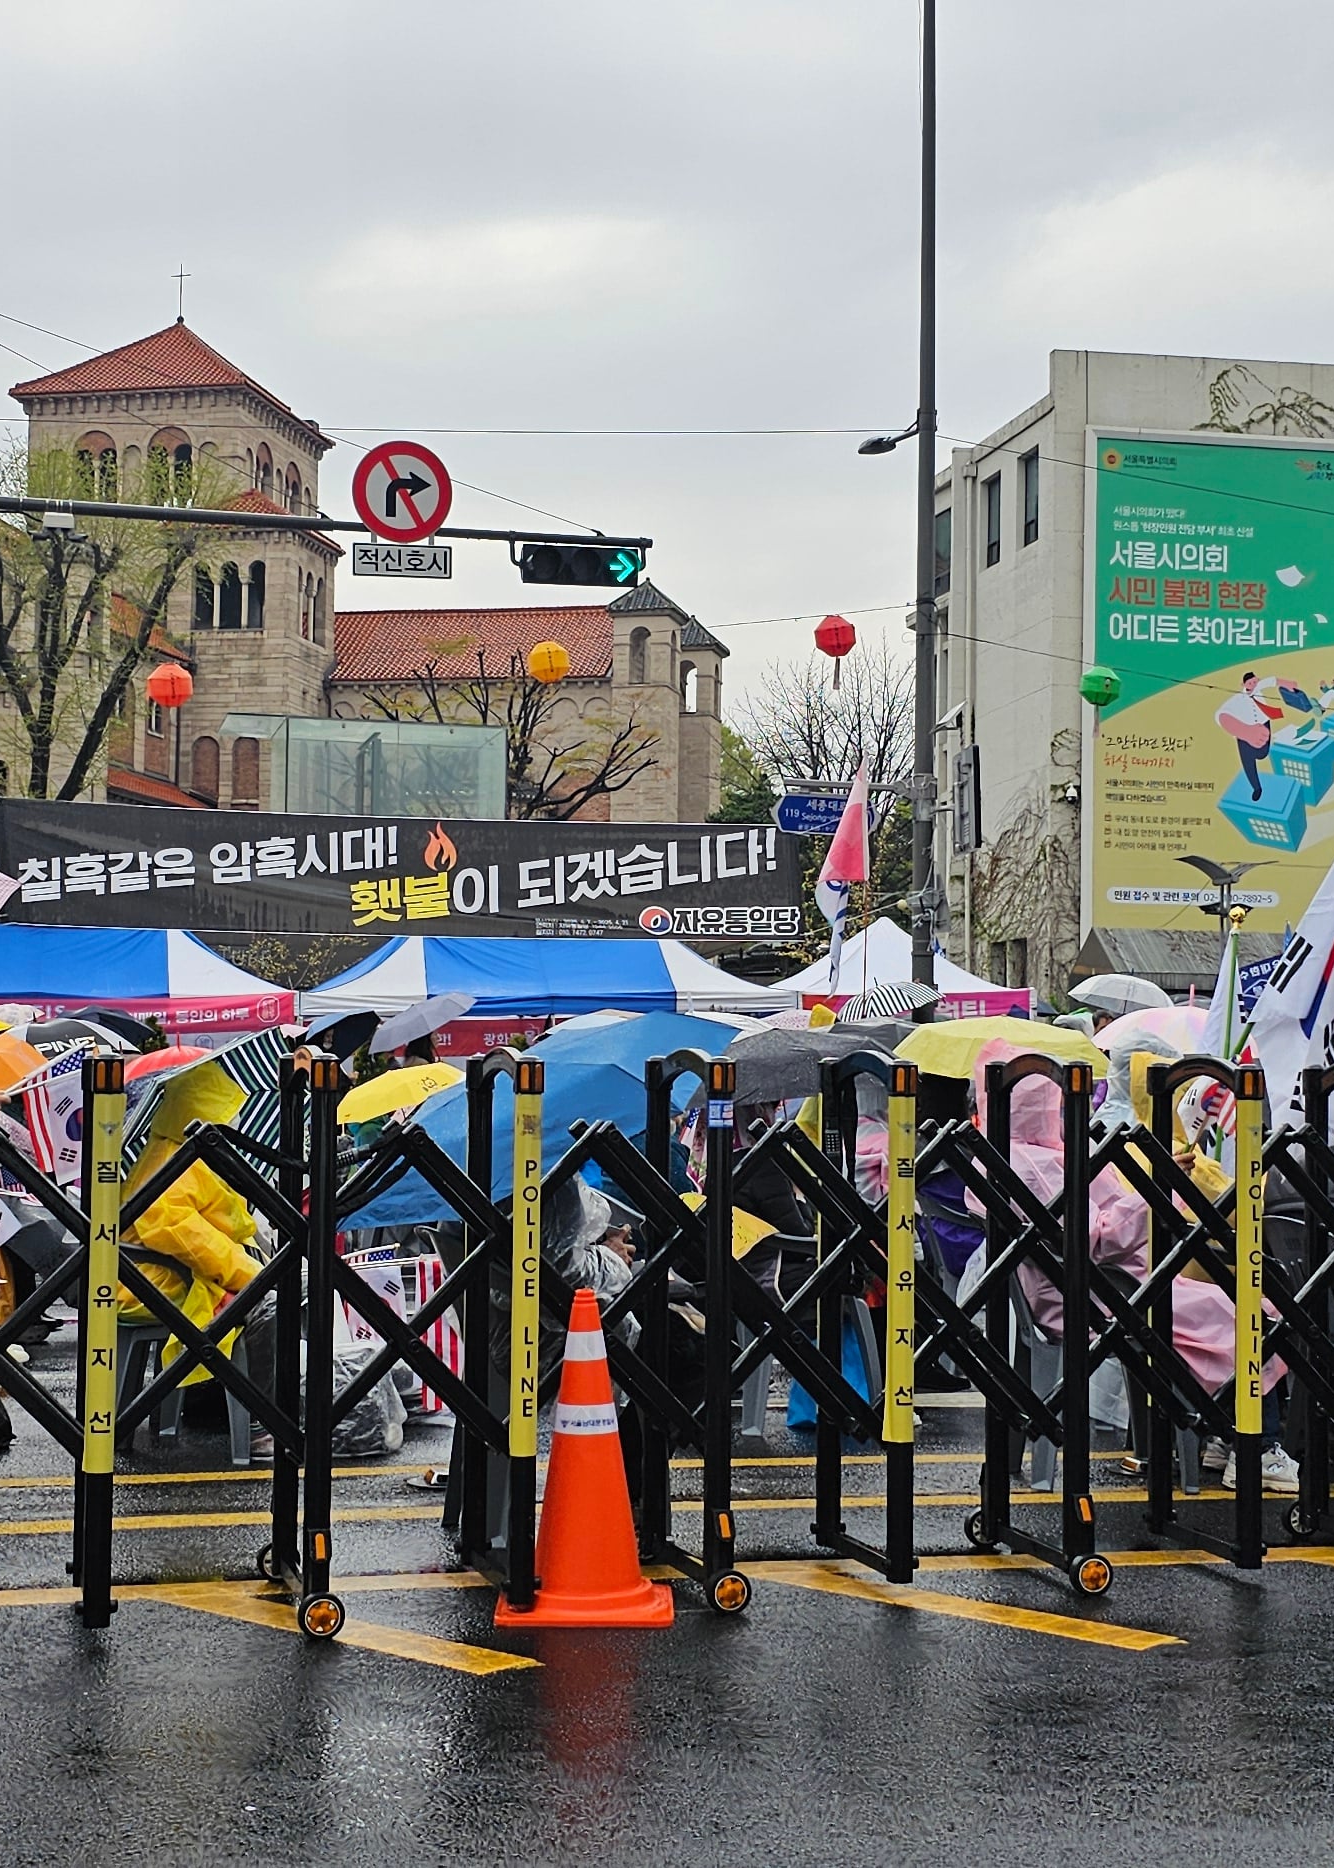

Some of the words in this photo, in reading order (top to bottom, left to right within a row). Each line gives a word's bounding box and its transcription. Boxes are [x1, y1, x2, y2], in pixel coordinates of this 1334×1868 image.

[357, 548, 449, 575] 적신호시
[1109, 540, 1228, 573] 서울시의회
[1108, 575, 1156, 605] 시민
[1163, 578, 1210, 608] 불편
[1218, 581, 1267, 611] 현장
[1108, 612, 1179, 643] 어디든
[1186, 614, 1308, 649] 찾아갑니다
[785, 808, 800, 818] 119
[15, 847, 195, 904] 칠흑같은
[209, 825, 398, 888] 암흑시대!
[350, 866, 499, 928] 횃불이
[517, 827, 778, 909] 되겠습니다!
[1152, 891, 1161, 902] 및
[672, 905, 802, 936] 자유통일당
[33, 1035, 97, 1056] PING
[521, 1159, 538, 1298] POLICE
[1248, 1159, 1263, 1289] POLICE
[88, 1160, 118, 1435] 질서유지선
[894, 1157, 916, 1408] 질서유지선
[520, 1325, 535, 1418] LINE
[1249, 1314, 1260, 1399] LINE
